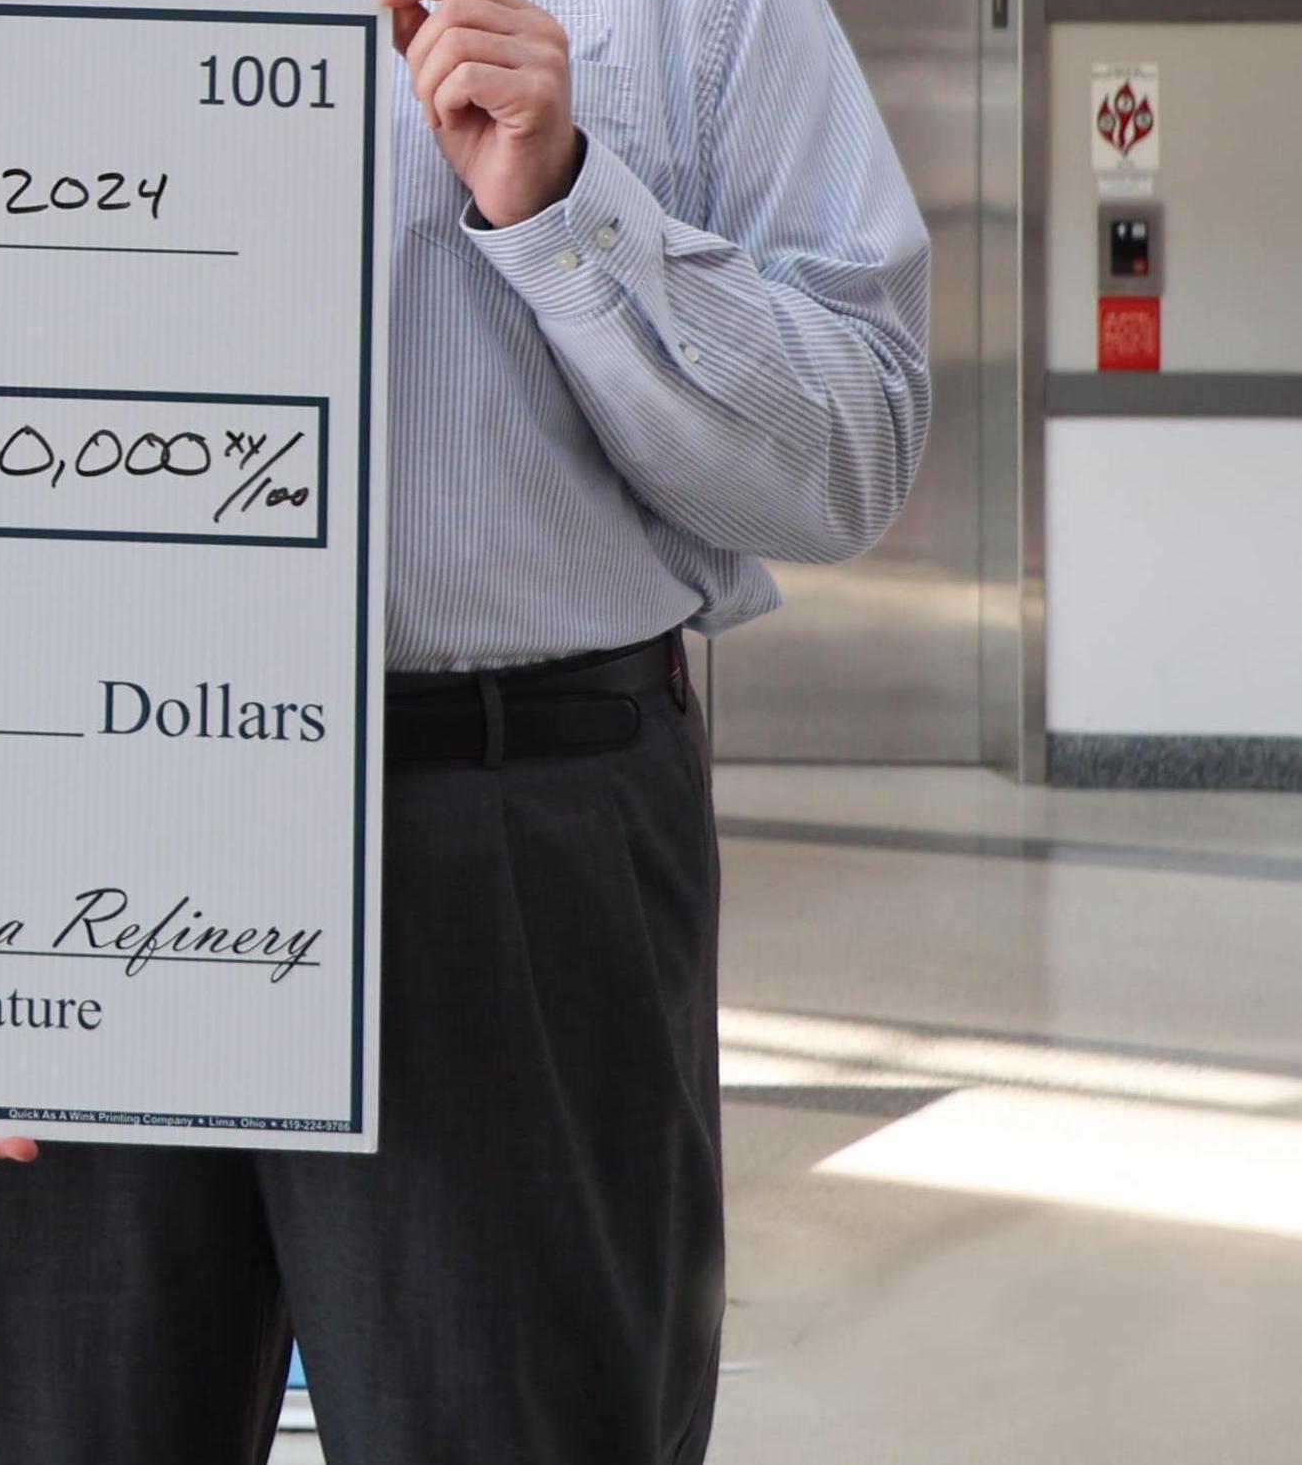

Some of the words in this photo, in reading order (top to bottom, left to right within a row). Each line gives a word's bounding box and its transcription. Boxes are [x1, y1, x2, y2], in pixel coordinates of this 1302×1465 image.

[200, 55, 334, 108] 1001
[3, 169, 167, 219] 2024
[99, 681, 325, 742] Dollars
[52, 887, 323, 983] Refinery
[8, 1108, 40, 1120] Quick
[42, 1110, 56, 1120] As
[58, 1111, 67, 1121] A
[69, 1111, 96, 1122] Wink
[98, 1113, 141, 1125] Printing
[142, 1114, 194, 1127] Company
[240, 1119, 267, 1129] Ohio
